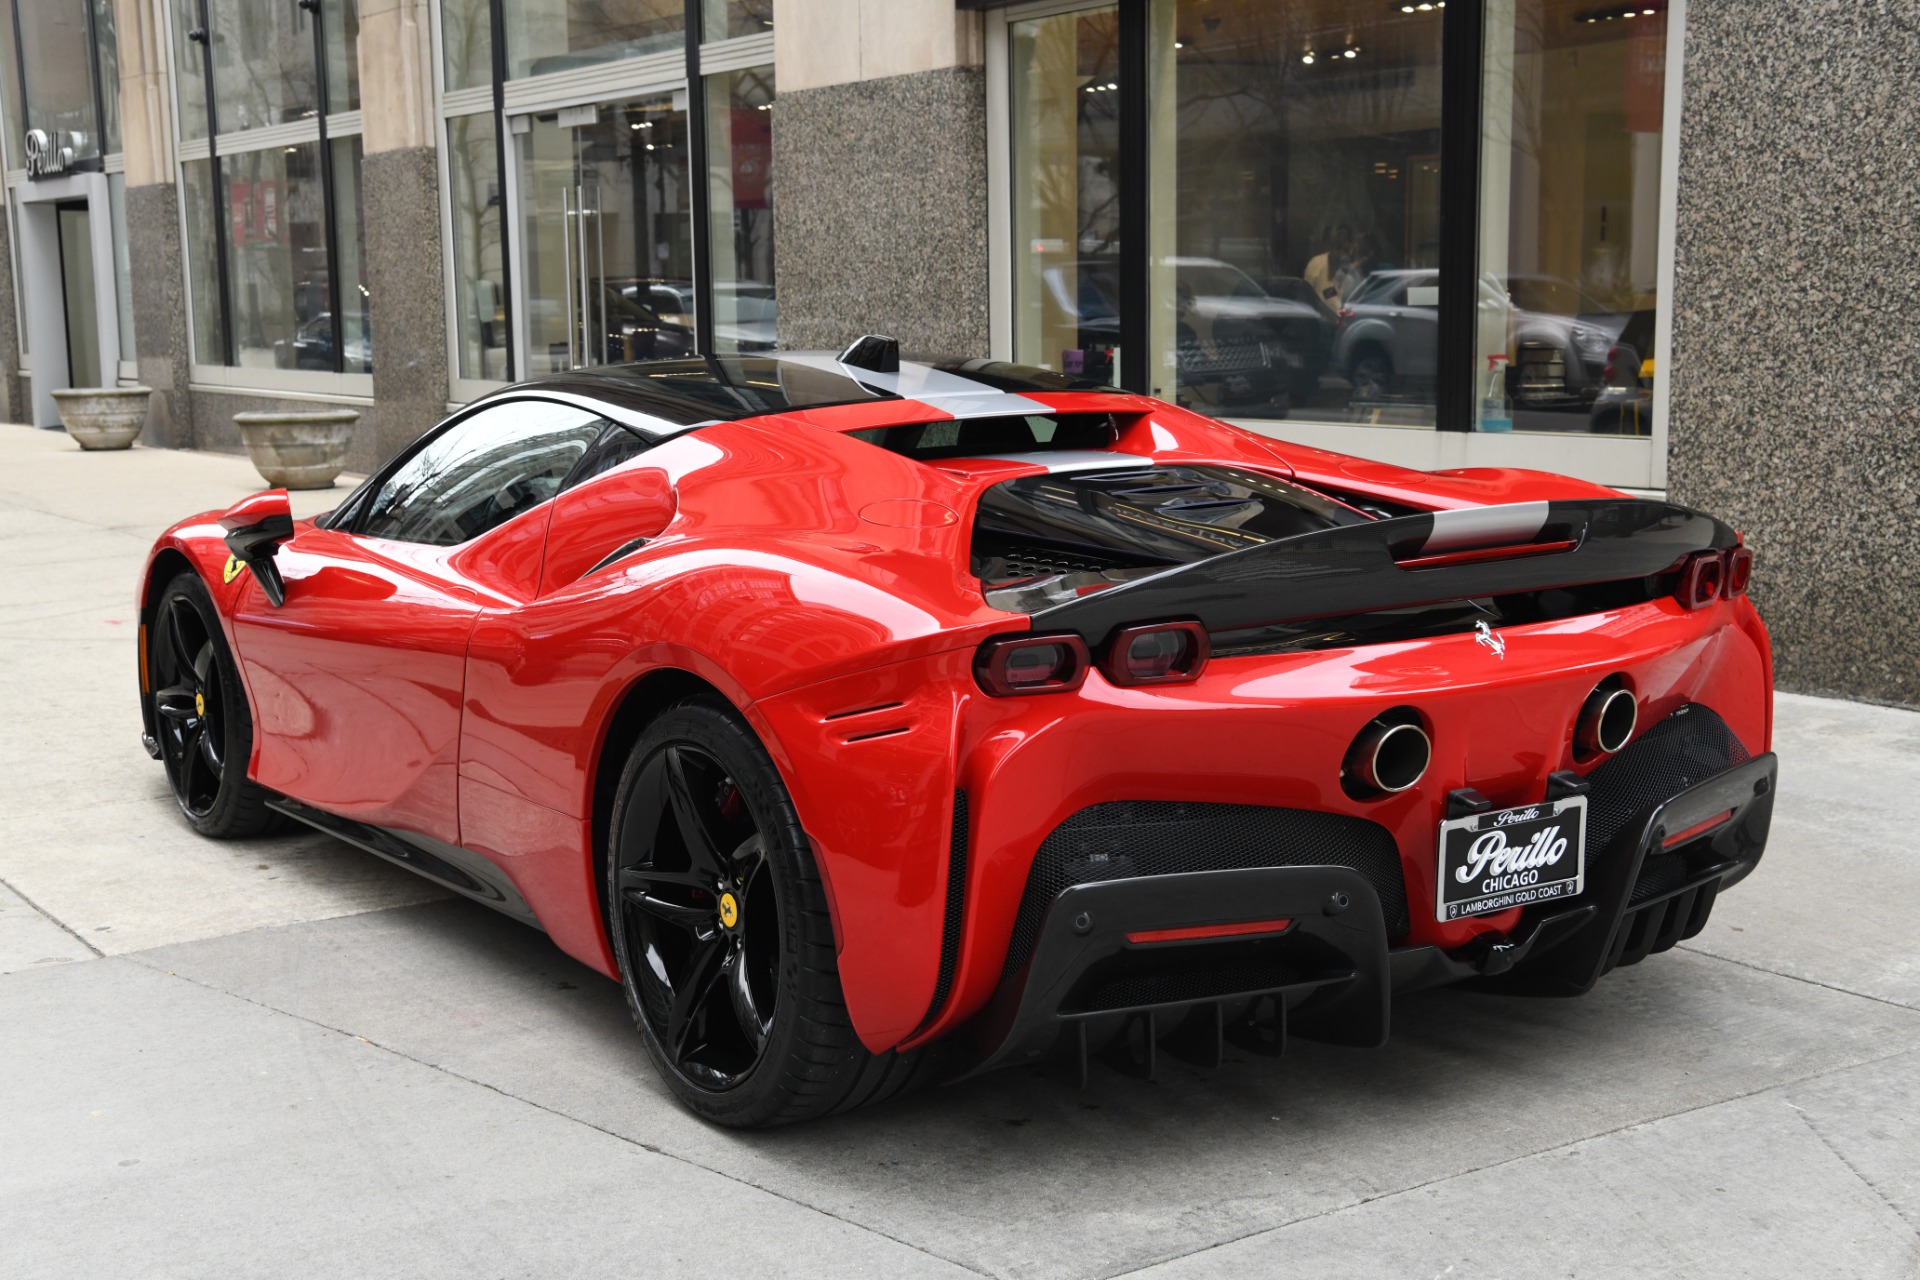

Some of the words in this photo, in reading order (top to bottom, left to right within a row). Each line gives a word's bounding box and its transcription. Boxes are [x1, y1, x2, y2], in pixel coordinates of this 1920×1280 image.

[25, 129, 70, 177] Perillo
[1493, 807, 1540, 827] Perillo
[1455, 825, 1568, 884] Perillo
[1482, 869, 1539, 893] CHICAGO
[1461, 894, 1515, 915] LAMBORGHINI
[1515, 889, 1537, 902] GOLD
[1538, 884, 1563, 898] COAST
